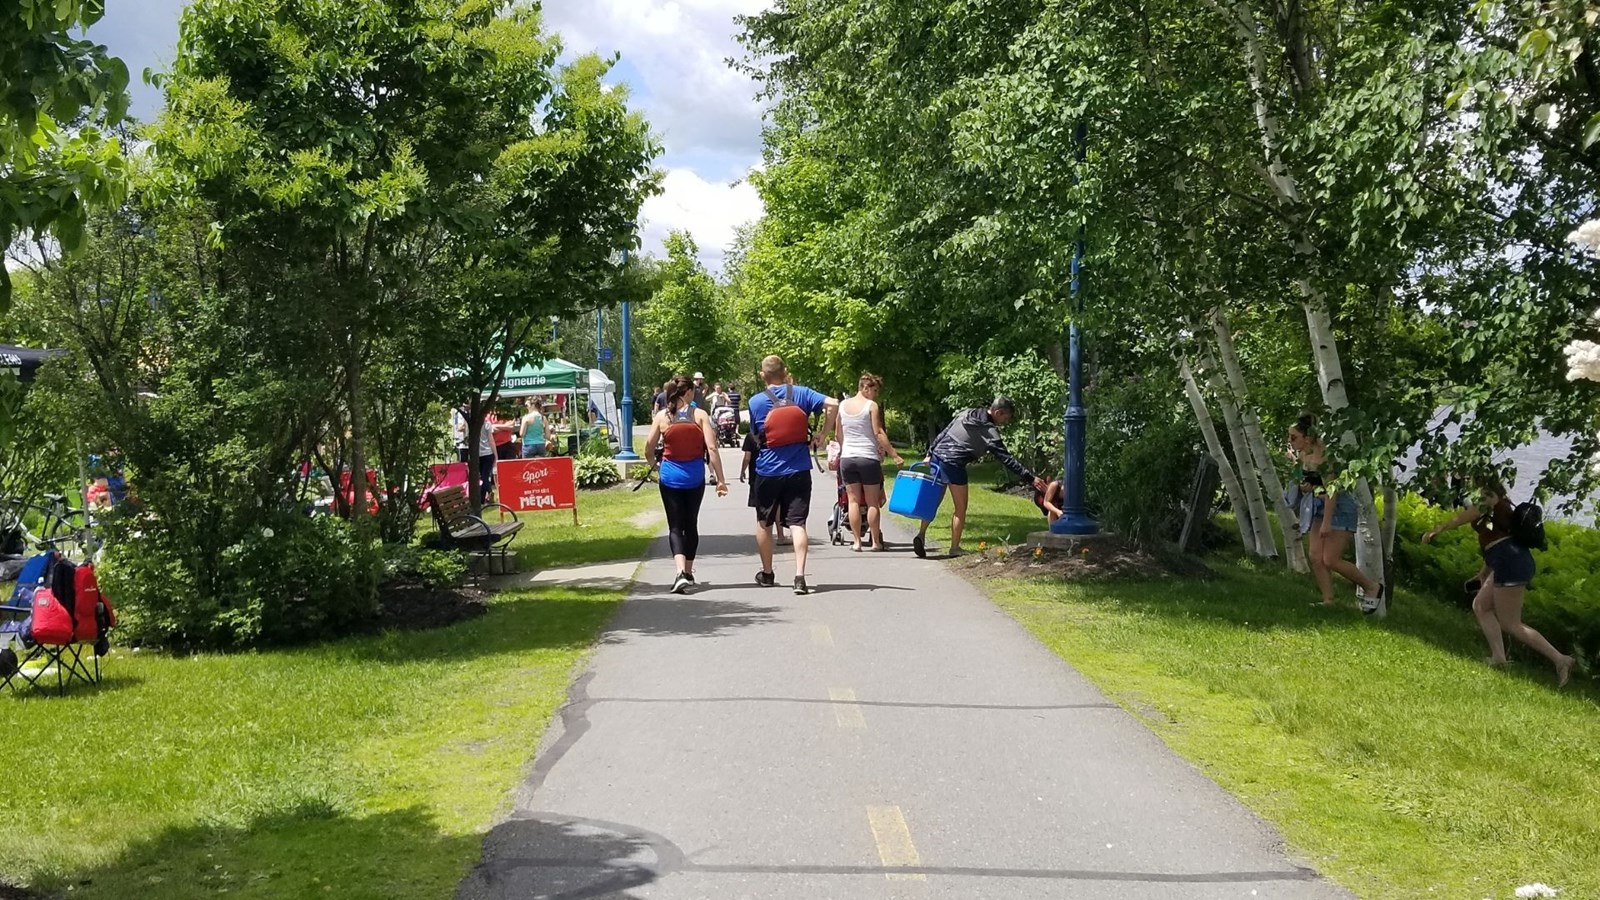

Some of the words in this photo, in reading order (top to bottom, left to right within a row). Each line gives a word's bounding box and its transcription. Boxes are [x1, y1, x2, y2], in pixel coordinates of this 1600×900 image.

[500, 375, 546, 389] eigneurie
[522, 467, 549, 484] Sport
[519, 494, 556, 510] MÉTAL
